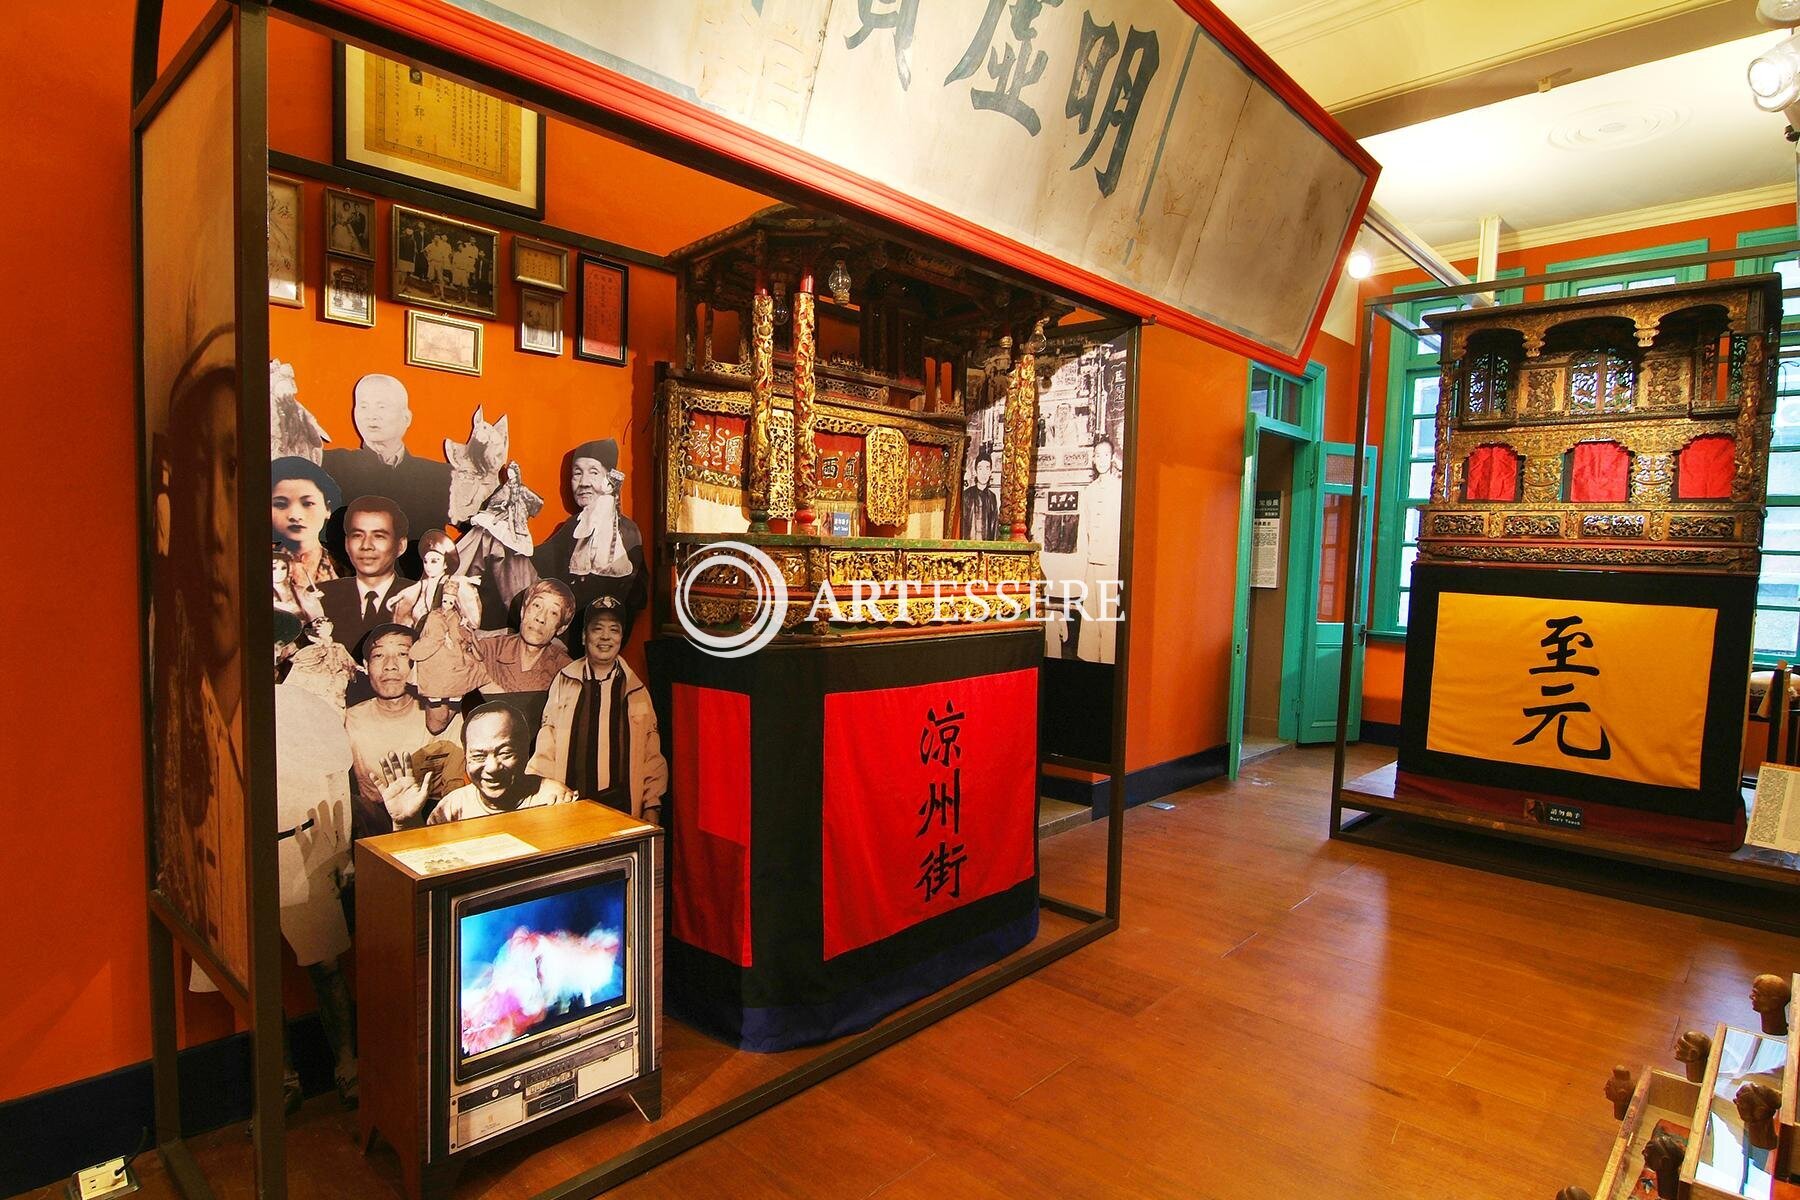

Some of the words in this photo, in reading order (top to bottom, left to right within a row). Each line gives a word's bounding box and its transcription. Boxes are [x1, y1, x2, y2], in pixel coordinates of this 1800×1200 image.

[1512, 614, 1612, 761] 至元
[914, 700, 968, 902] 涼州街
